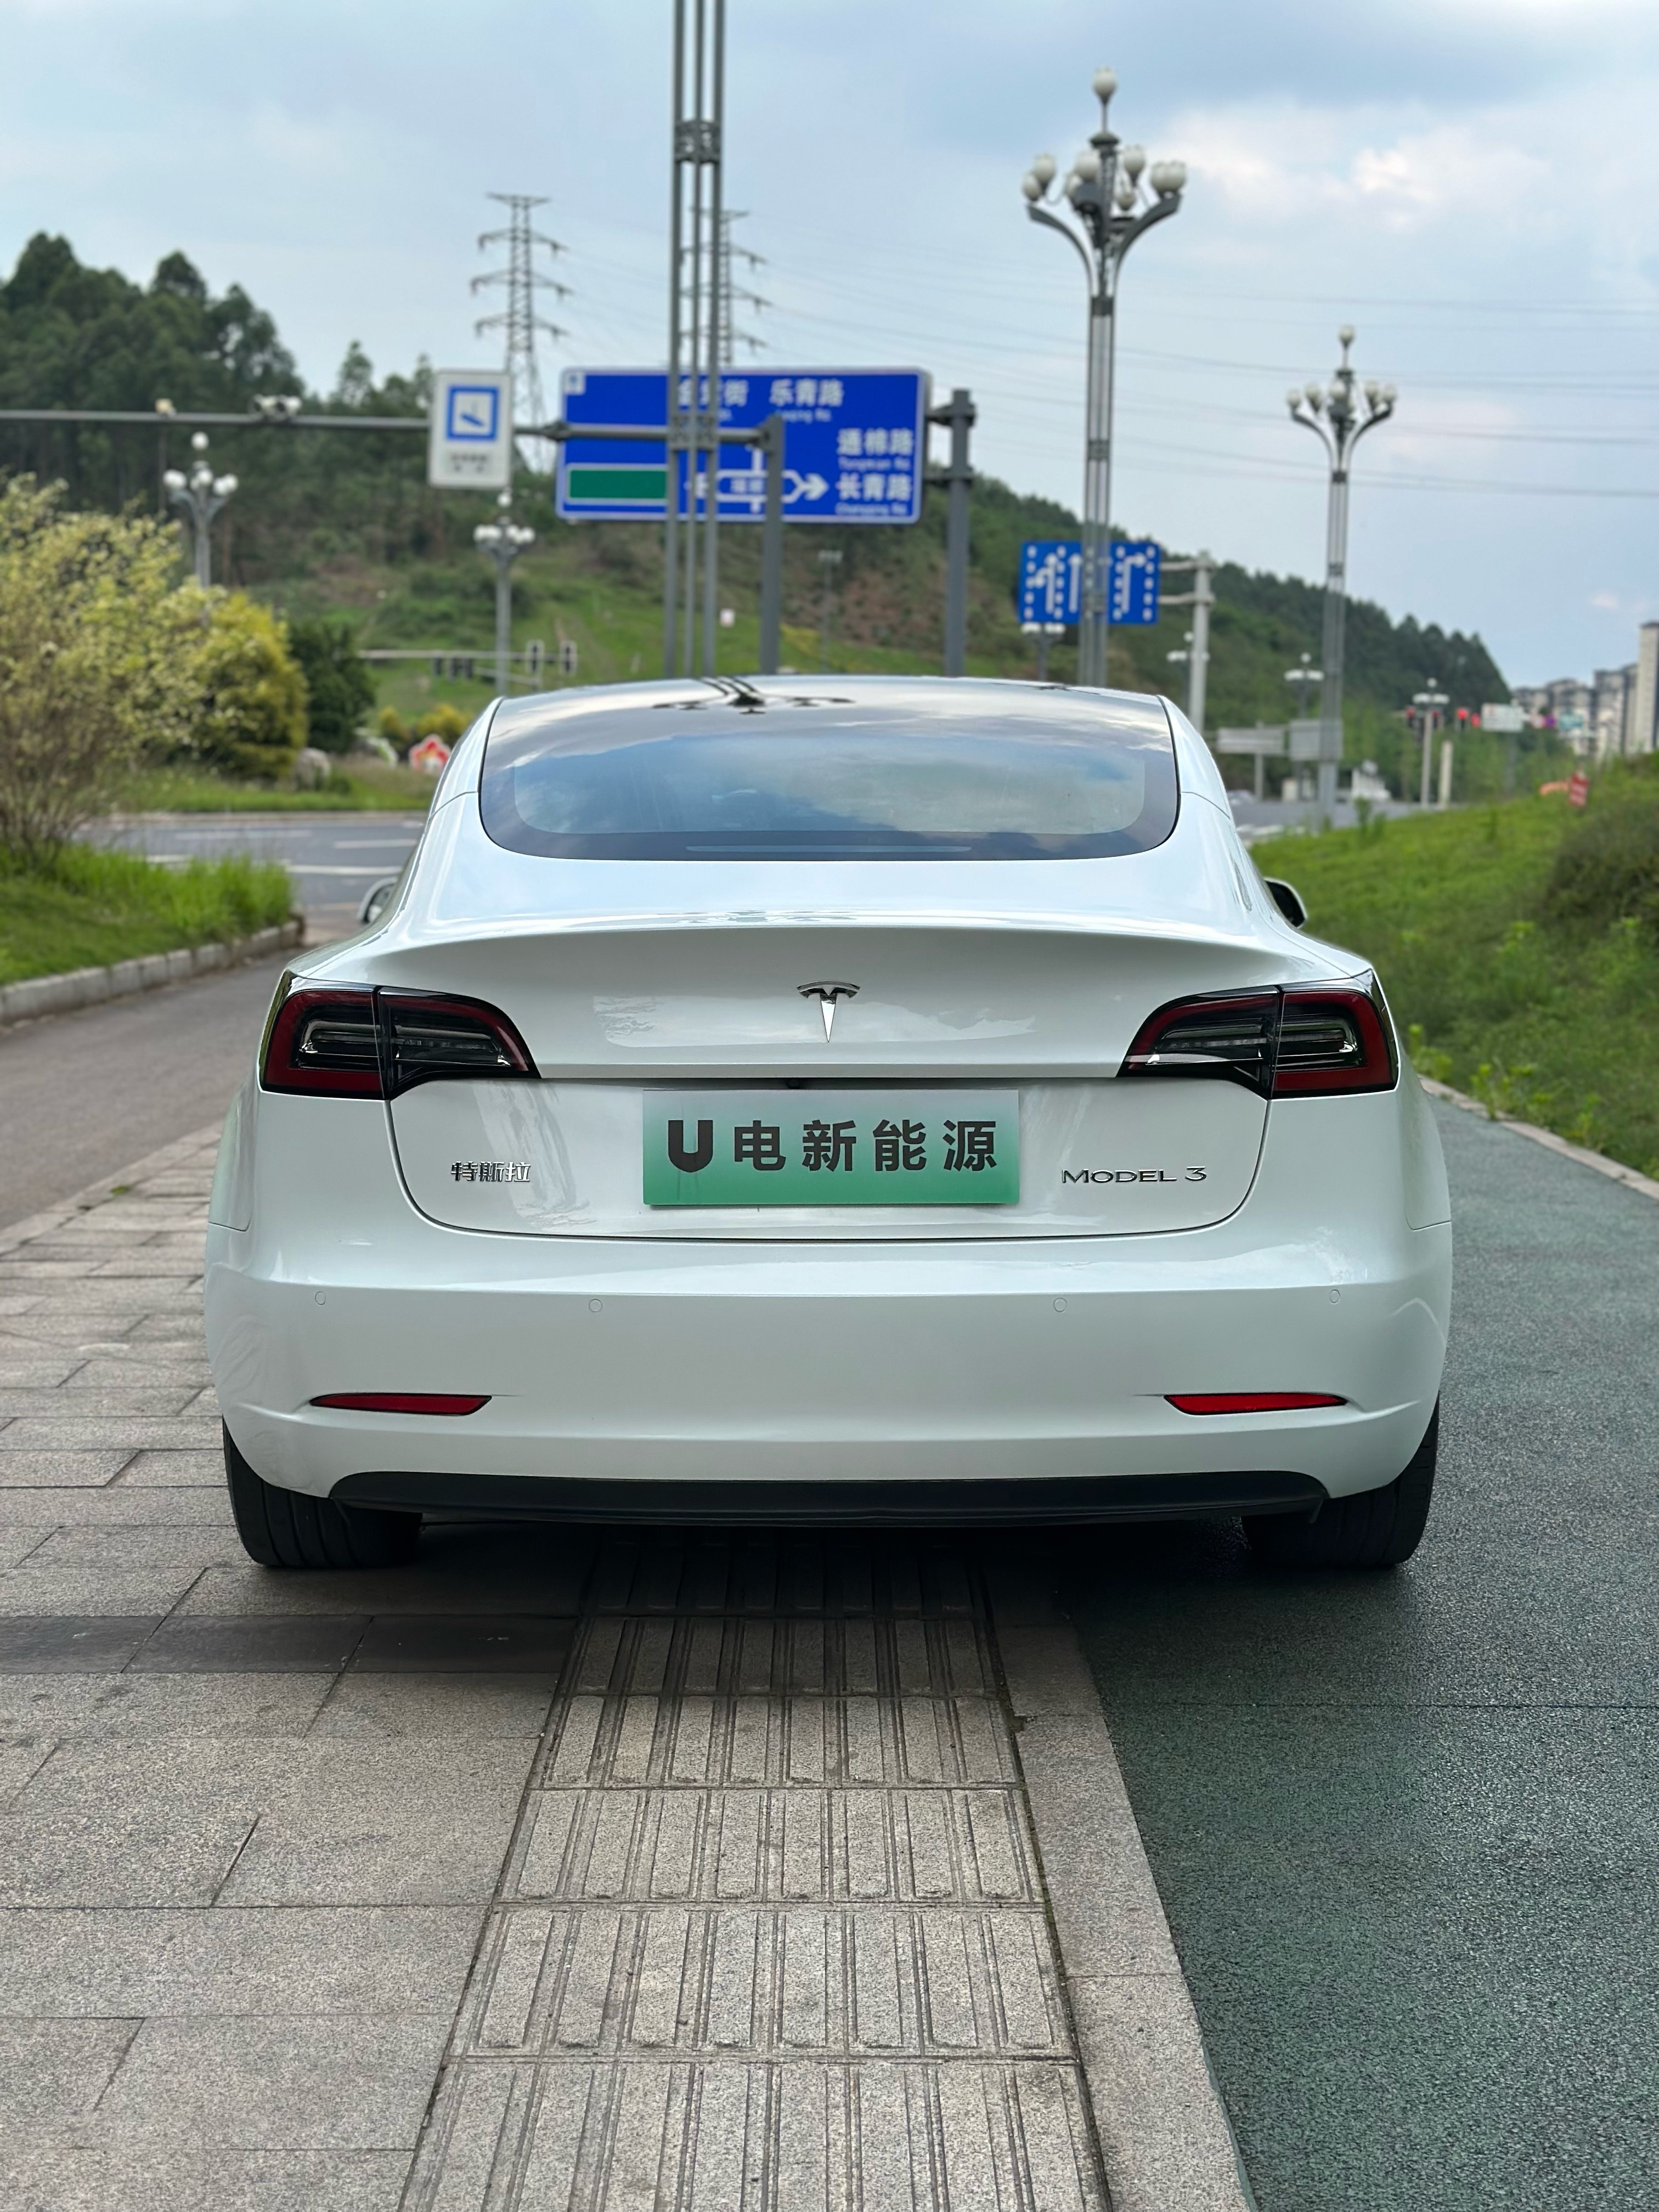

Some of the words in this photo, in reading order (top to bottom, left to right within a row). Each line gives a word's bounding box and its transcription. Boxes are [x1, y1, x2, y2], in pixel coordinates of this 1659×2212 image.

[769, 379, 843, 407] 乐青路
[836, 472, 912, 501] 长青路
[450, 1161, 532, 1182] 特斯拉
[1062, 1169, 1177, 1183] MODEL
[1184, 1165, 1207, 1182] 3
